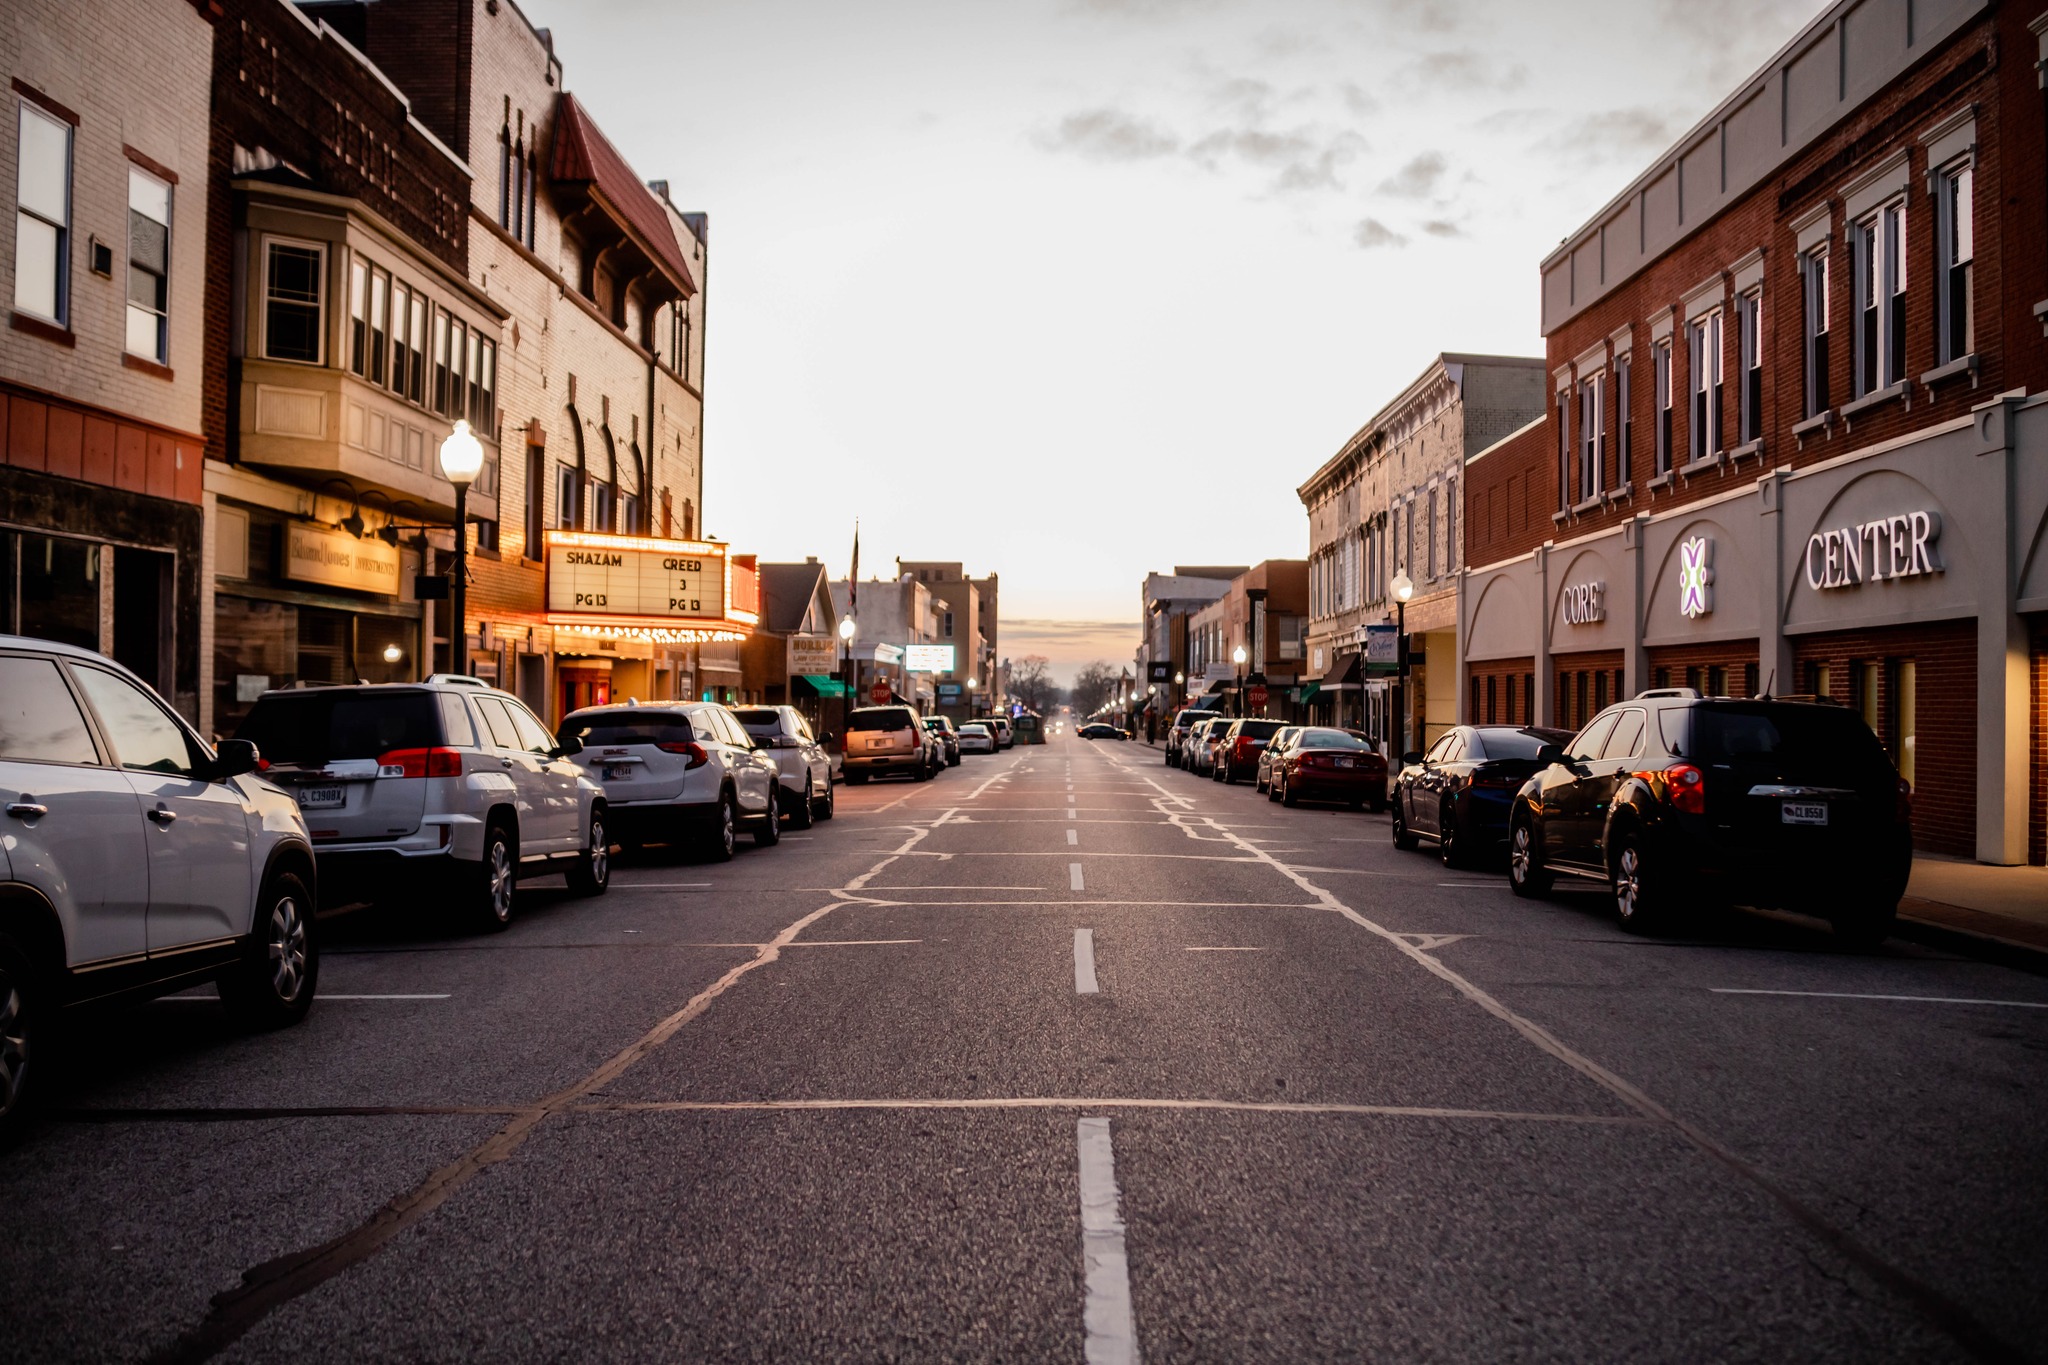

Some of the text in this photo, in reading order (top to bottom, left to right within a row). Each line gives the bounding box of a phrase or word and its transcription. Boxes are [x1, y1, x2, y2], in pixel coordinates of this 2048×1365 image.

[291, 536, 350, 567] Edward Jones
[1806, 511, 1935, 590] CENTER
[355, 556, 395, 576] INVESTMENTS
[566, 552, 622, 567] SHAZAM
[663, 558, 702, 572] CREED
[679, 579, 687, 590] 3
[575, 593, 607, 606] PG 13
[669, 598, 700, 611] PG 13
[1562, 581, 1600, 625] CORE
[793, 640, 834, 651] NORRIS
[872, 689, 890, 699] STOP
[1250, 692, 1268, 701] STOP
[311, 789, 341, 801] C390BX
